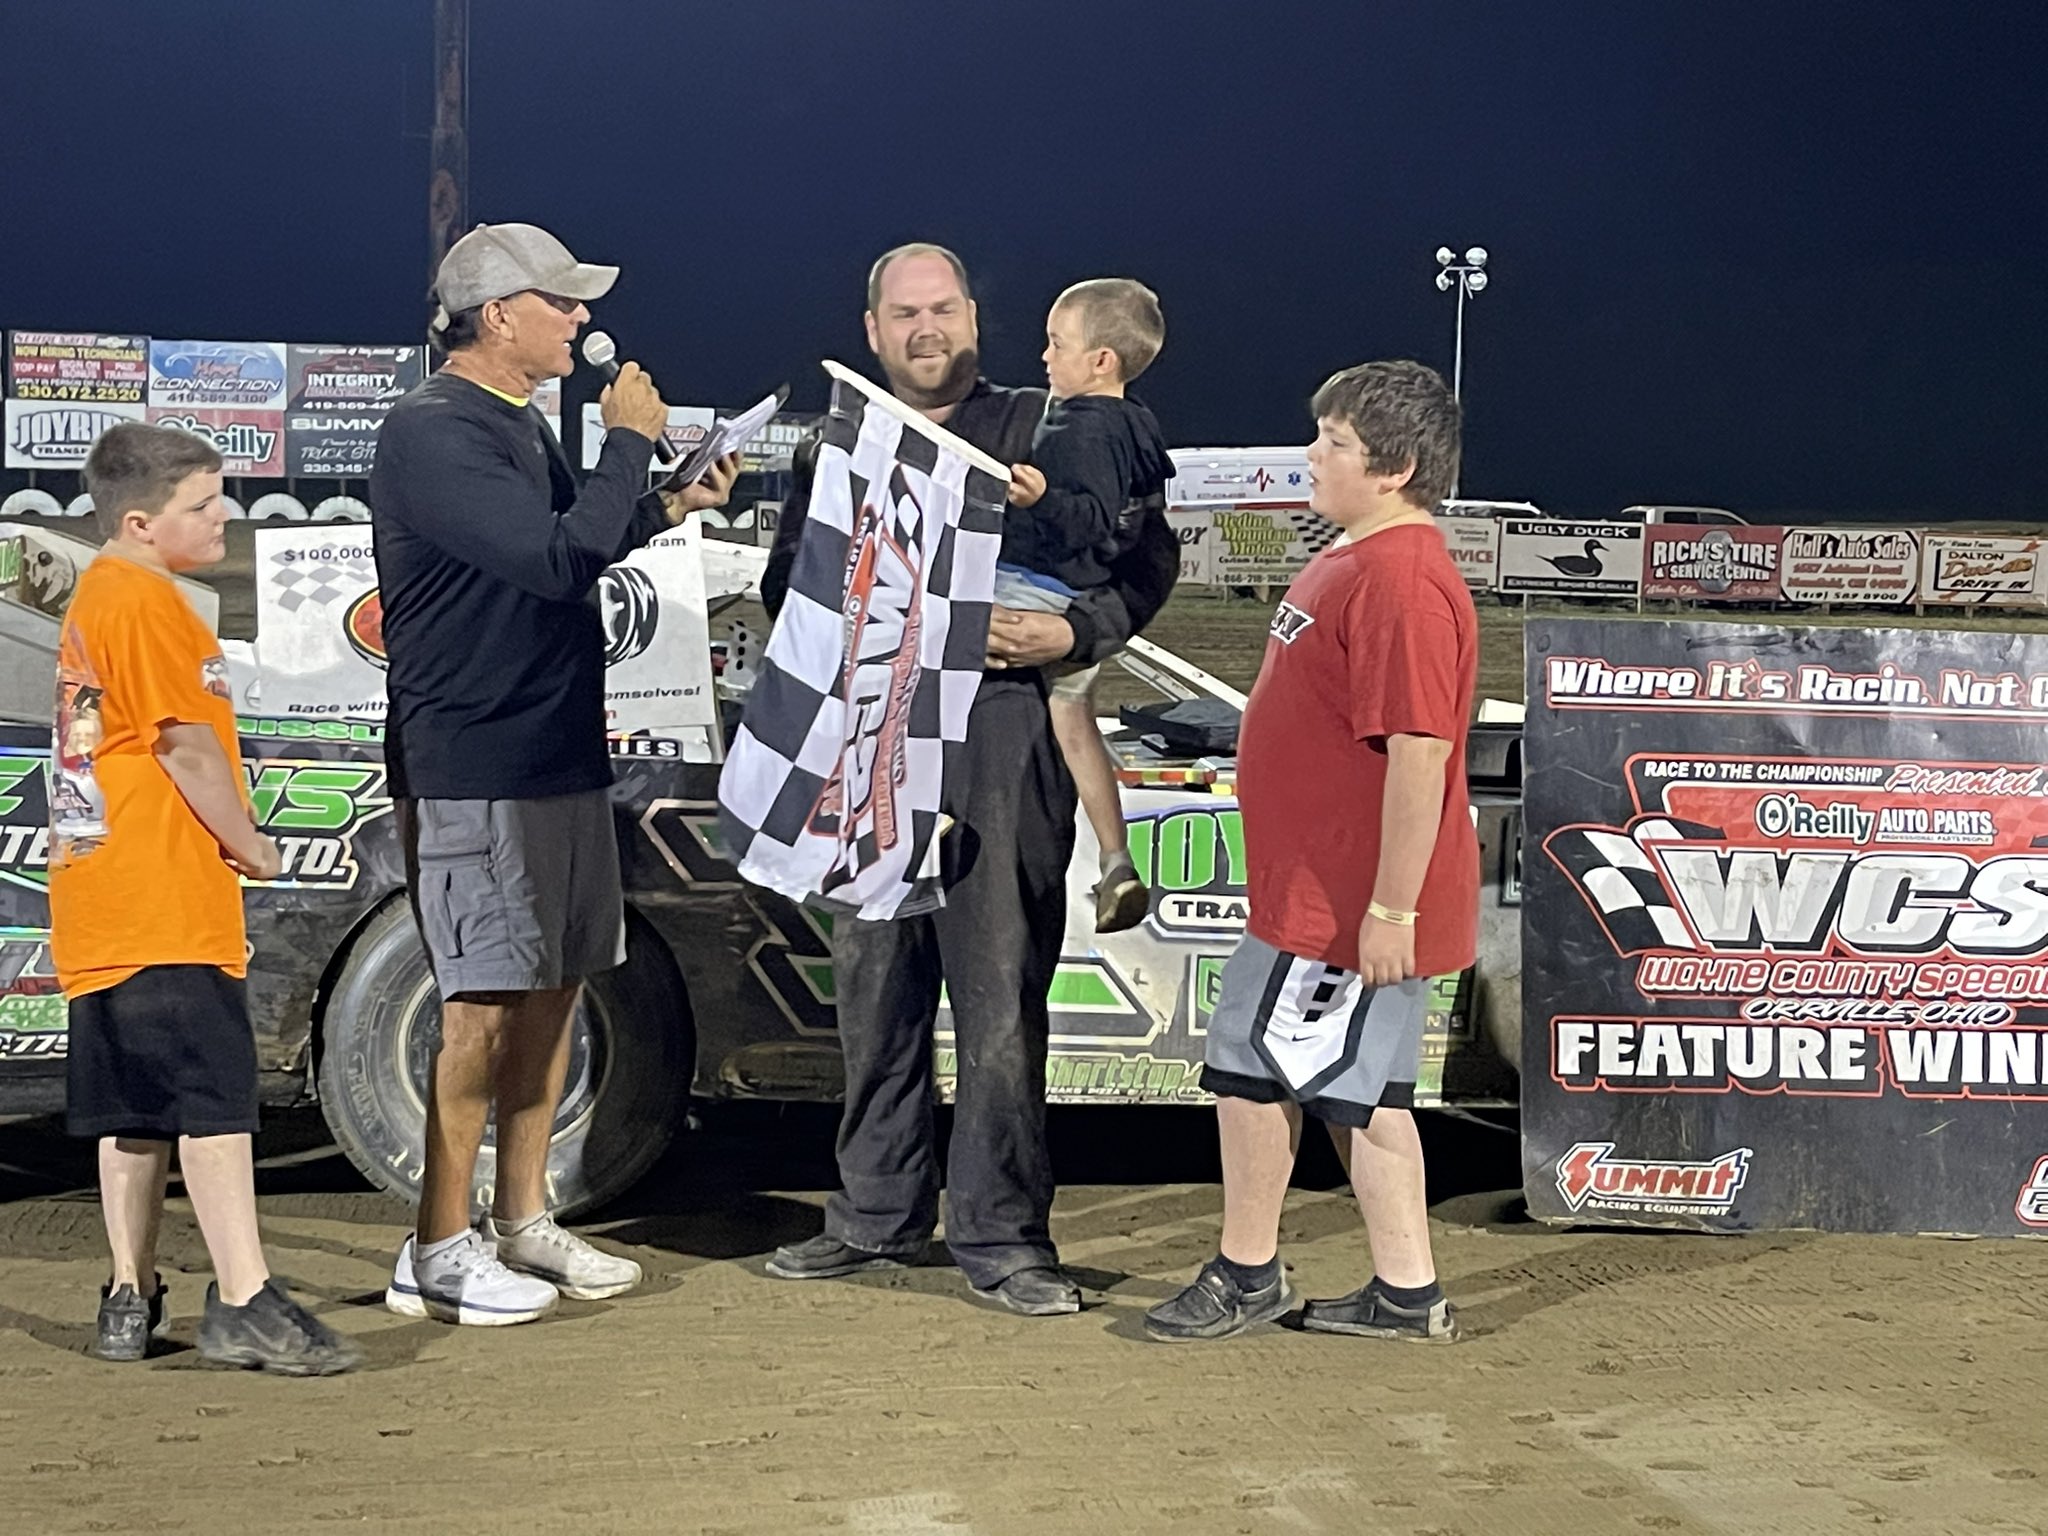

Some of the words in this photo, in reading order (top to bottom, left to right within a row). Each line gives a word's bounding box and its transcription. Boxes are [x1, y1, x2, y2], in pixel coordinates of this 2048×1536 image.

[15, 345, 39, 357] NOW
[40, 346, 76, 359] HIRING
[77, 347, 145, 361] TECHNICIANS
[14, 362, 35, 373] TOP
[36, 363, 56, 373] PAY
[152, 377, 282, 392] CONNECTION
[307, 373, 396, 387] INTEGRITY
[18, 385, 141, 400] 330.472.2520
[1212, 511, 1273, 528] Medina
[1220, 526, 1298, 542] Mountain
[1517, 523, 1569, 535] UGLY
[1574, 527, 1629, 537] DUCK
[1228, 541, 1286, 556] Motors
[1790, 532, 1834, 558] Hall's
[1834, 533, 1871, 559] Auto
[1871, 534, 1911, 560] Sales
[284, 547, 374, 562] $100,000
[1652, 540, 1725, 567] RICH'S
[1729, 543, 1778, 570] TIRE
[1948, 550, 2005, 561] DALTON
[1655, 566, 1665, 578] &
[1669, 563, 1721, 579] SERVICE
[1725, 565, 1770, 580] CENTER
[1950, 579, 2004, 589] DRIVE
[2007, 580, 2030, 590] IN
[1863, 592, 1899, 600] 8900
[1549, 660, 1697, 697] Where
[1942, 673, 2019, 706] Not
[288, 703, 340, 714] Race
[348, 700, 390, 713] with
[1644, 761, 1689, 778] RACE
[1693, 763, 1716, 778] TO
[1720, 764, 1752, 779] THE
[1756, 765, 1883, 783] CHAMPIONSHIP
[1885, 763, 2044, 795] Presented
[1755, 794, 1876, 844] O'Reilly
[1879, 808, 1930, 834] AUTO
[272, 836, 348, 877] TD.
[1658, 849, 2048, 950] WCS
[1921, 1002, 2013, 1024] OHIO
[1556, 1022, 1867, 1081] FEATURE
[1587, 1199, 1640, 1212] RACING
[1644, 1203, 1731, 1217] EQUIPMENT
